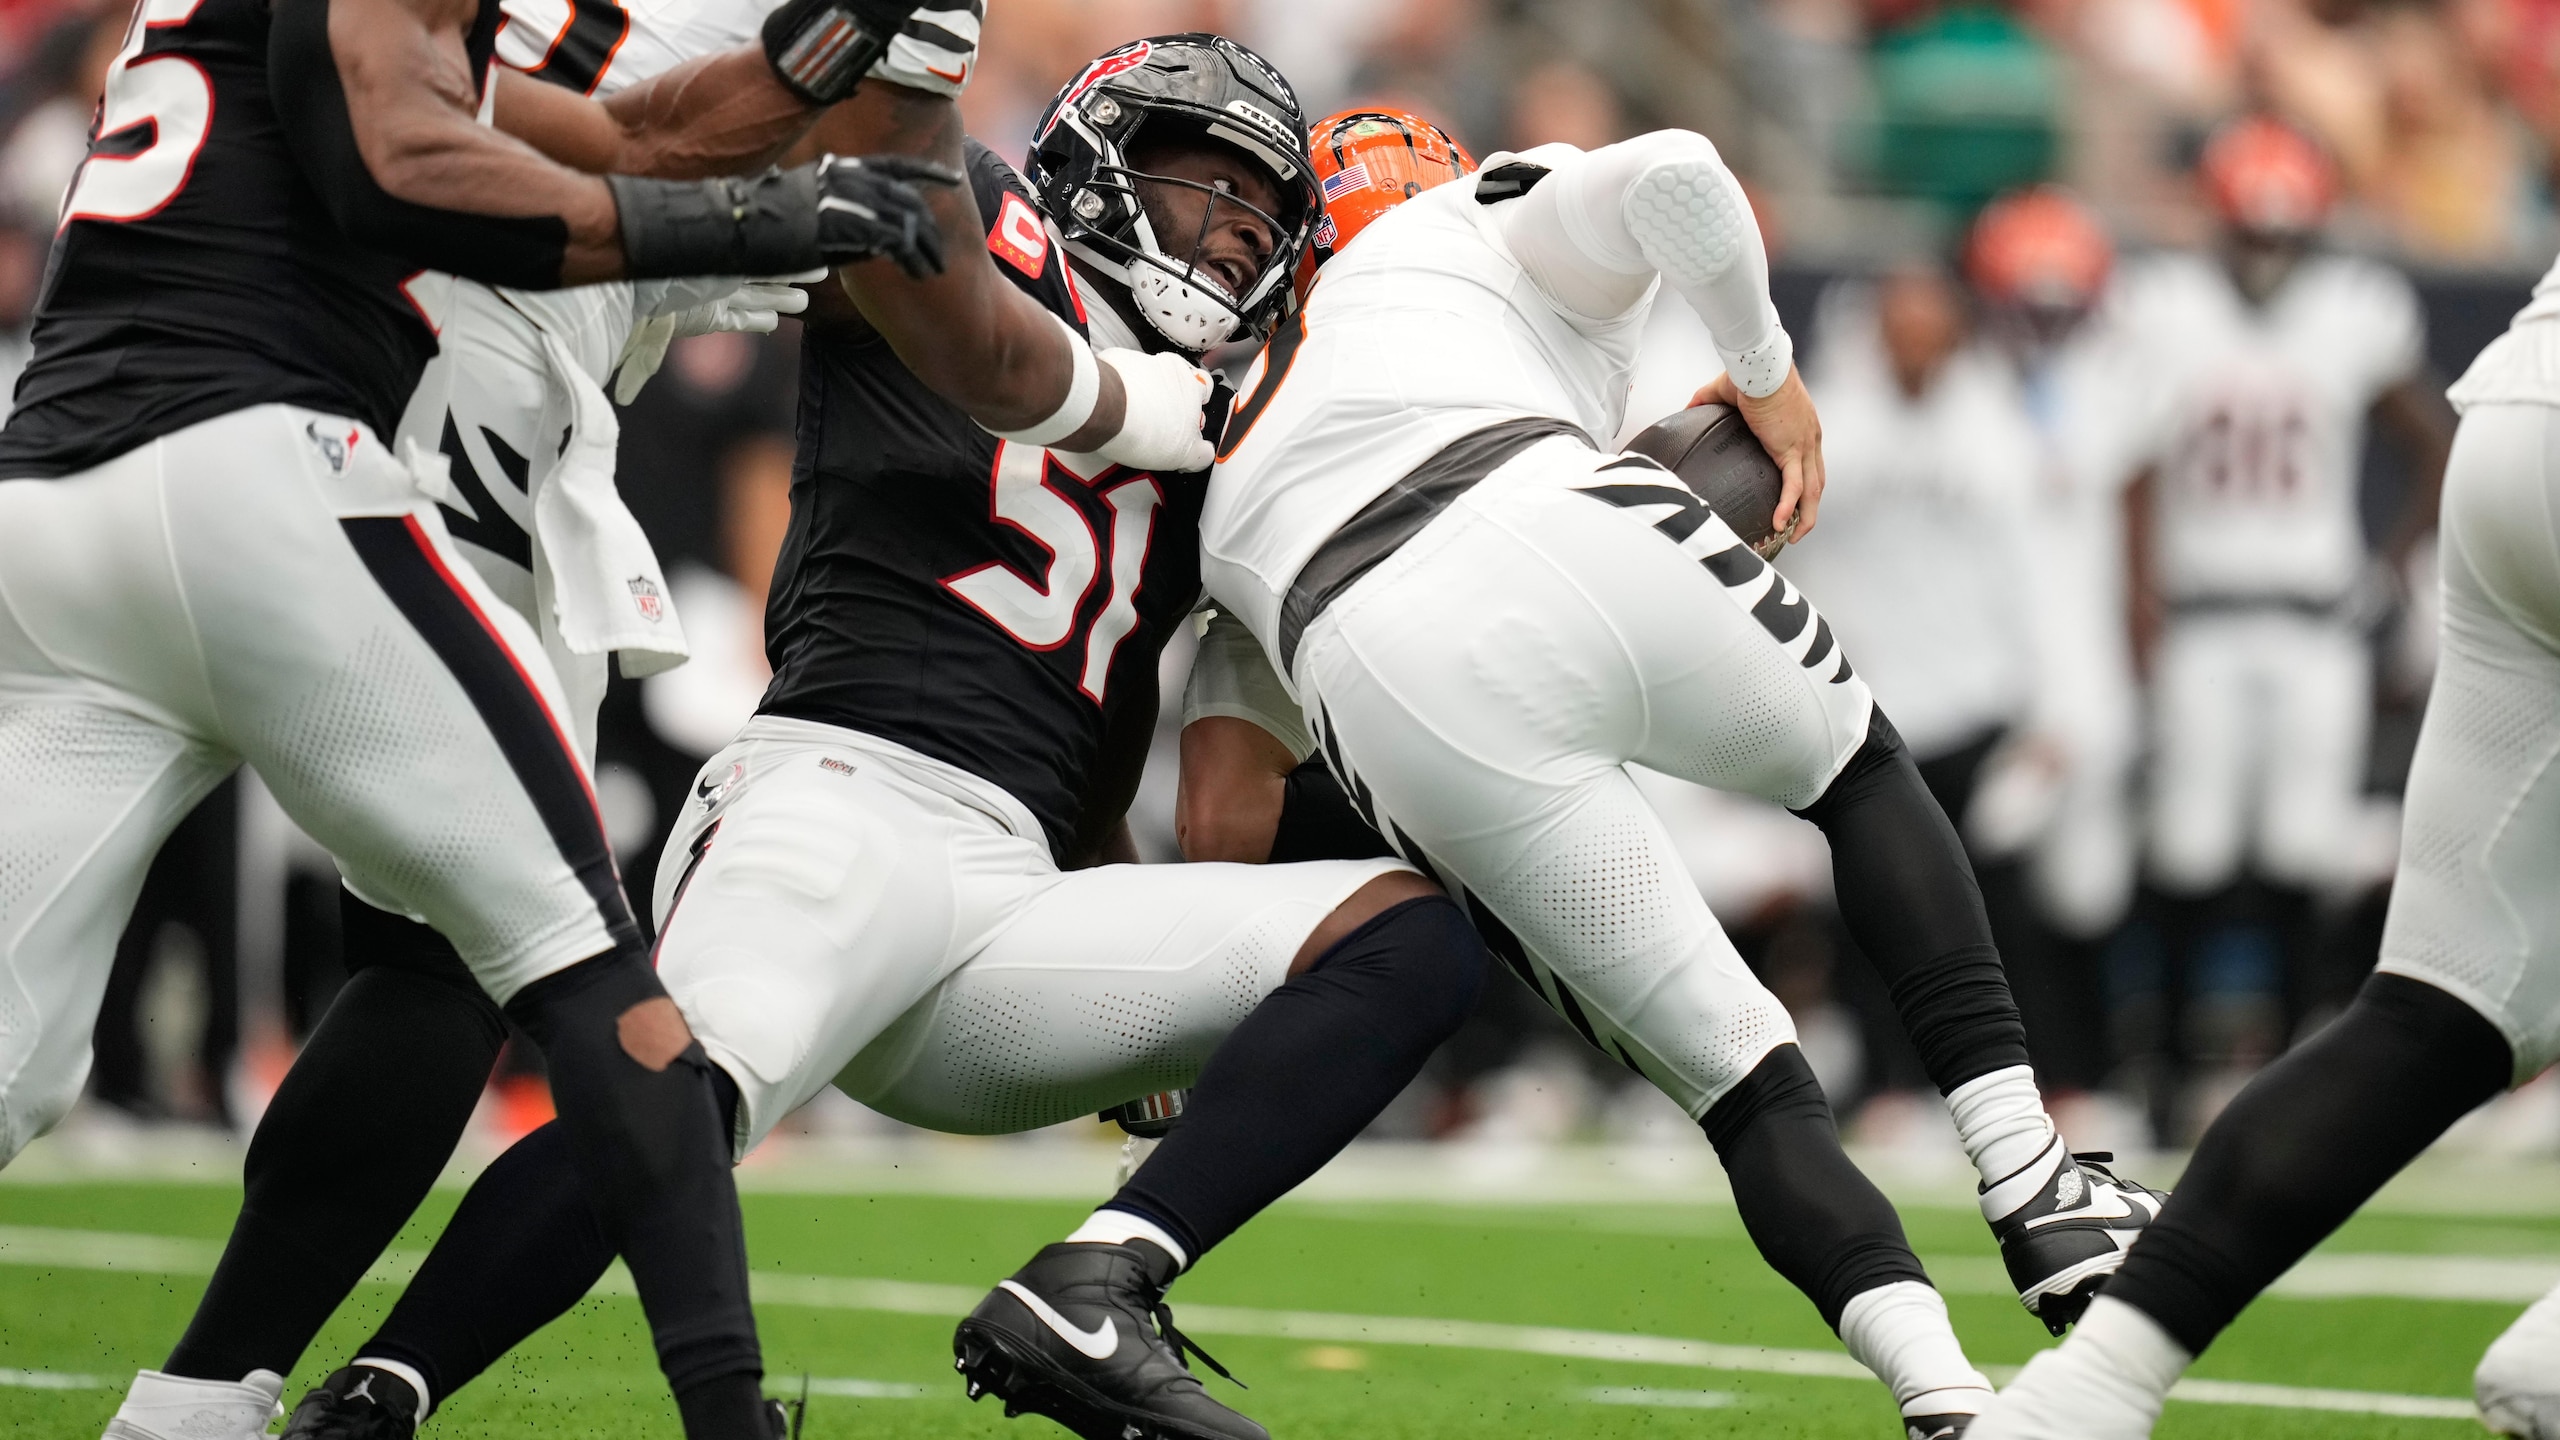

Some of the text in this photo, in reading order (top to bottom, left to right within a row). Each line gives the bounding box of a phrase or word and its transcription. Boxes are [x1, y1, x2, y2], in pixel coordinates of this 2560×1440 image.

[1239, 104, 1297, 147] TEXANS
[1002, 200, 1044, 258] C
[1315, 226, 1335, 245] NFL
[936, 437, 1165, 713] 51
